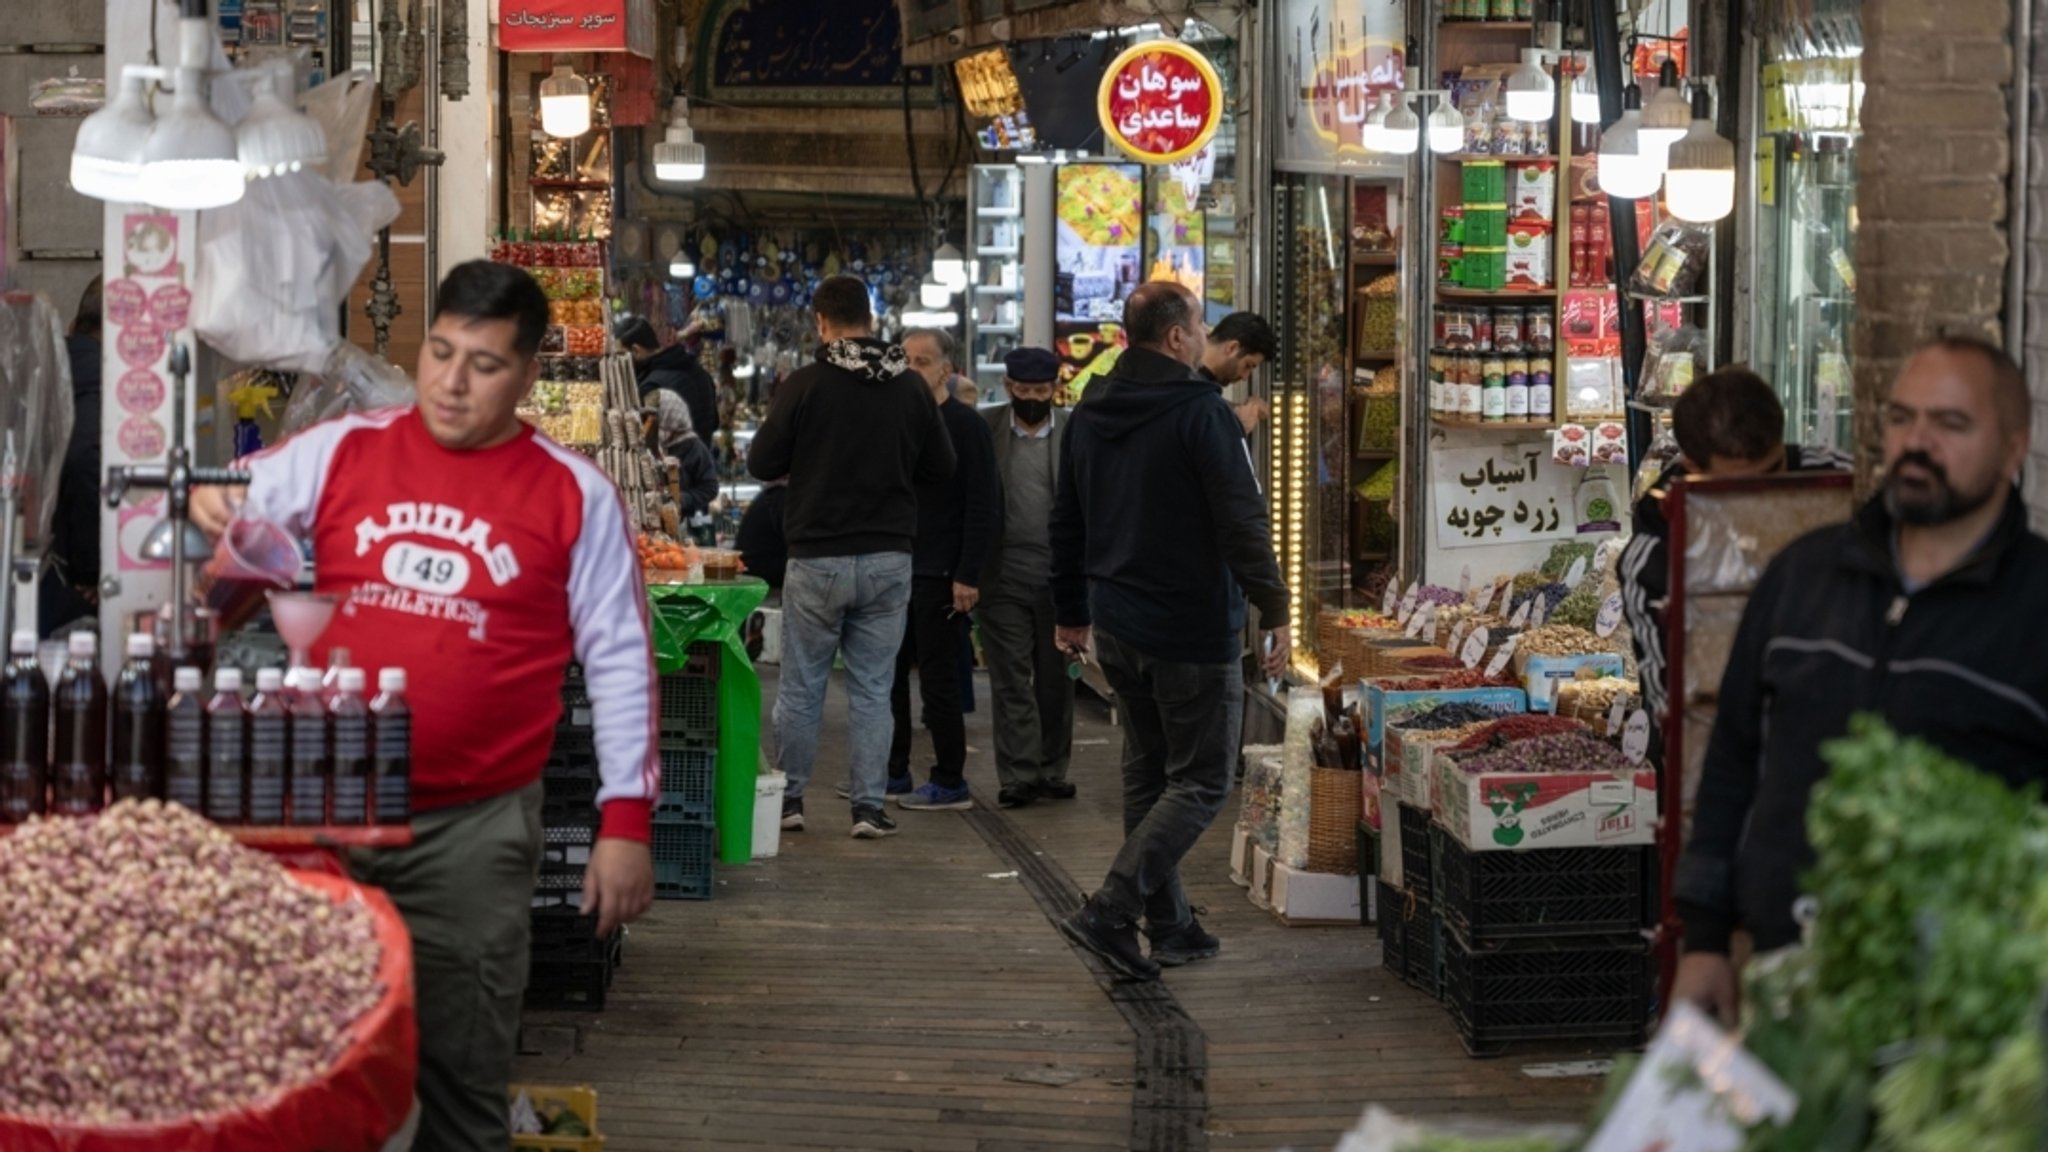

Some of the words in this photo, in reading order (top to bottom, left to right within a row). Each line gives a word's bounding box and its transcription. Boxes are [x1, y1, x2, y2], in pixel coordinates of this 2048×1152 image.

[505, 9, 574, 29] سبزیجات
[579, 11, 616, 30] سوپر
[1119, 65, 1201, 100] سوهان
[1119, 103, 1201, 135] ساعدی
[1460, 450, 1541, 495] آسیاب
[1447, 504, 1505, 537] چوبه
[1513, 497, 1559, 532] زرد
[355, 501, 521, 587] ADIDAS
